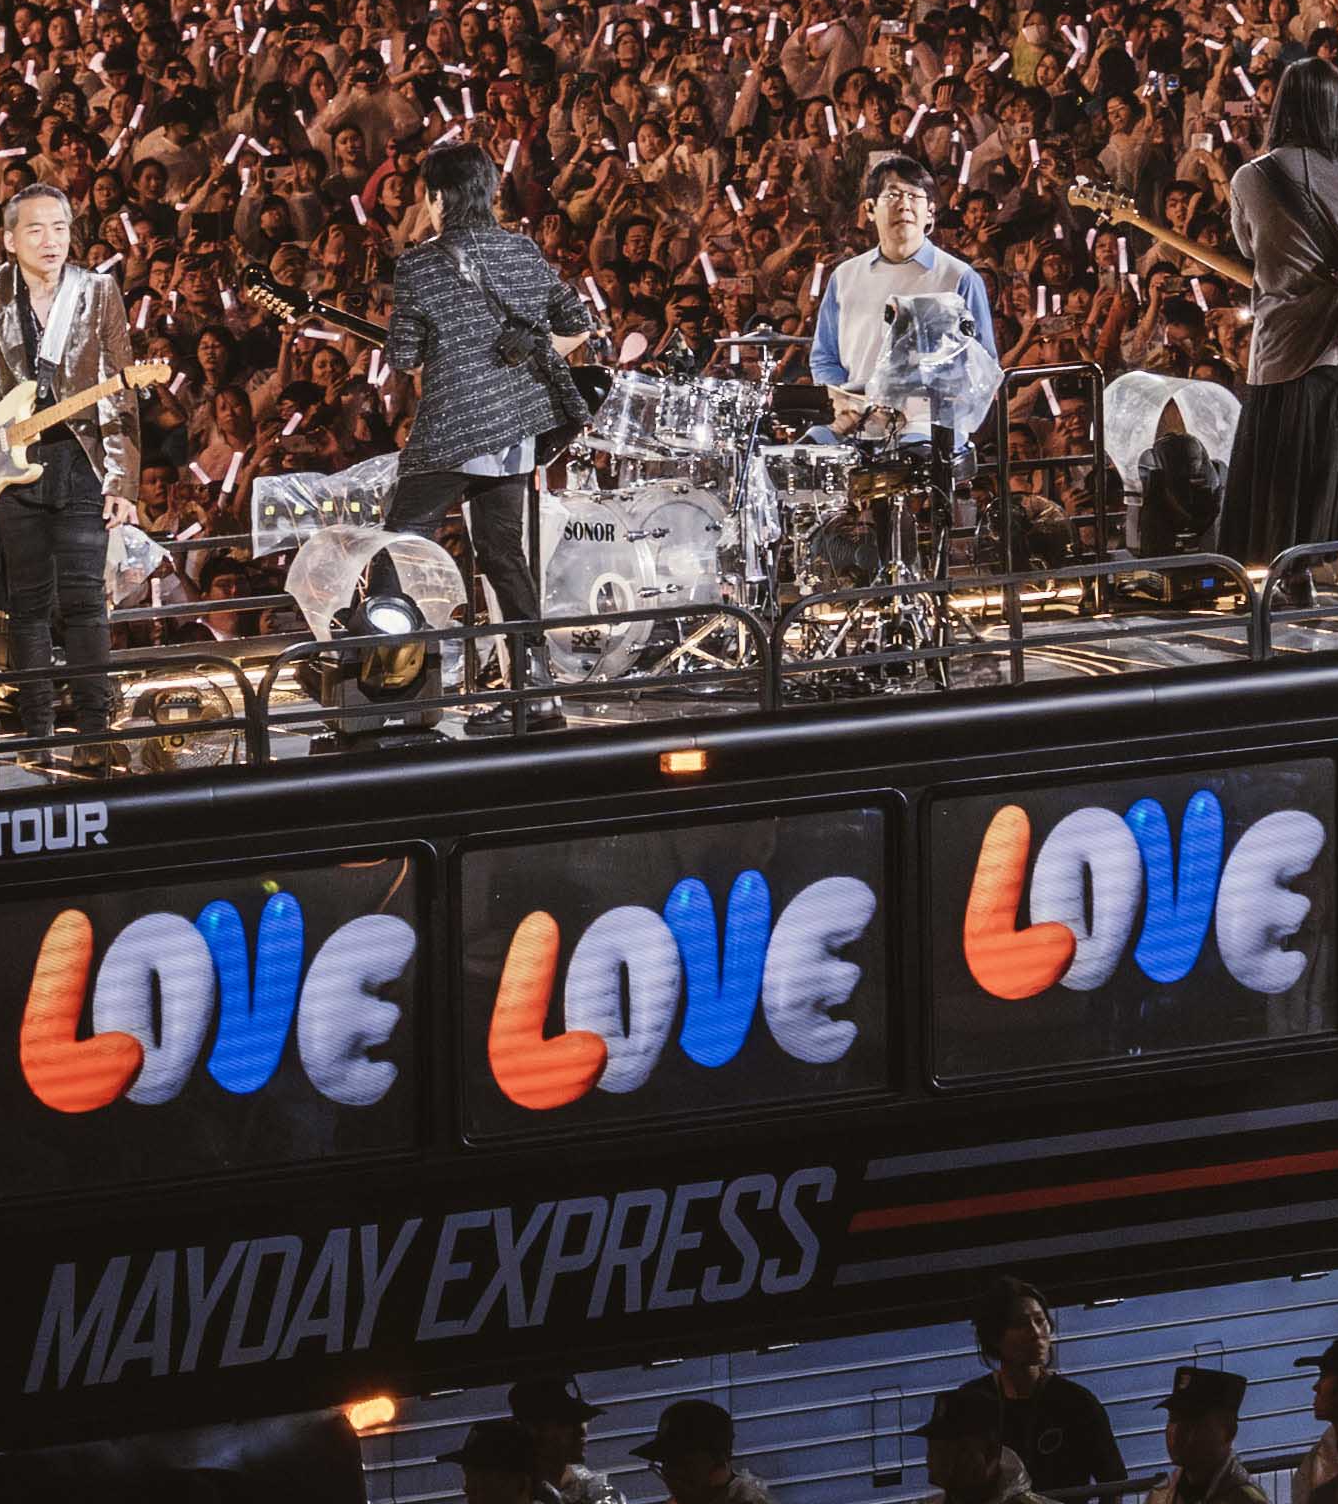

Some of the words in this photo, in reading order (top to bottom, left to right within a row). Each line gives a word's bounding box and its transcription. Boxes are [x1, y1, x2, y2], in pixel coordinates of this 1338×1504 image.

[563, 521, 615, 542] SONOR
[20, 892, 417, 1113] LOVE
[488, 870, 877, 1110] LOVE
[963, 790, 1326, 1000] LOVE
[24, 1218, 420, 1394] MAYDAY
[415, 1167, 839, 1339] EXPRESS
